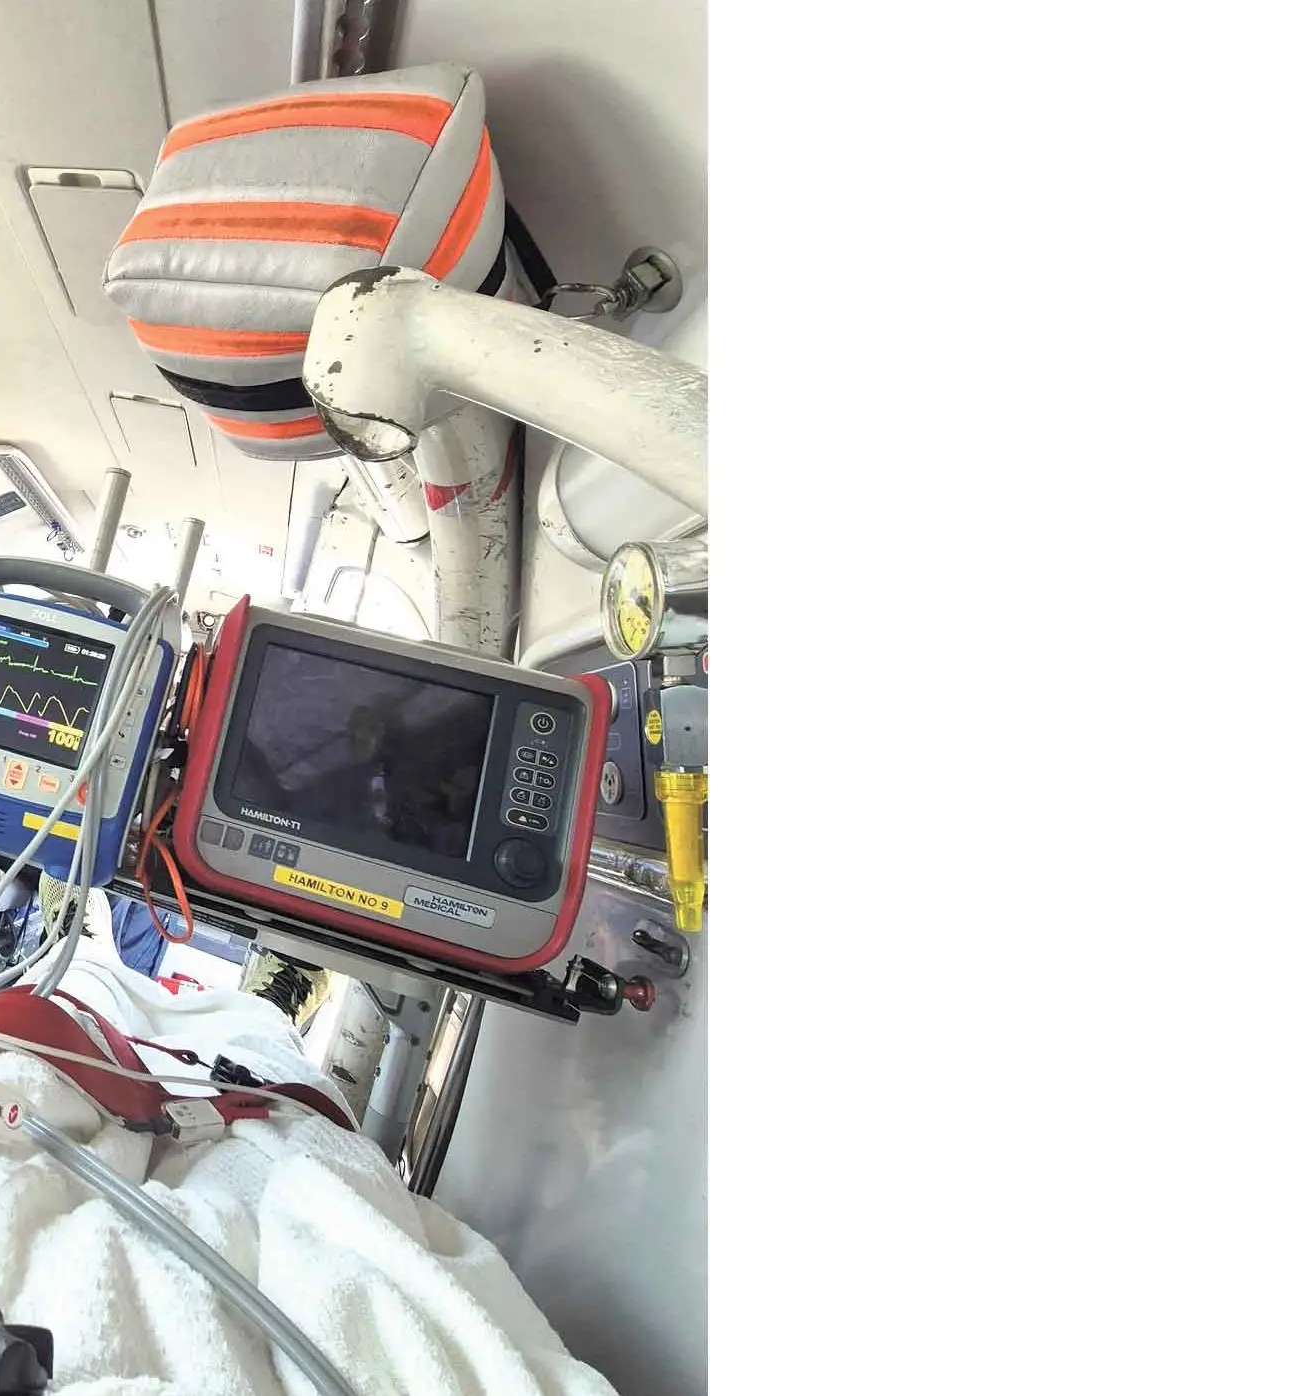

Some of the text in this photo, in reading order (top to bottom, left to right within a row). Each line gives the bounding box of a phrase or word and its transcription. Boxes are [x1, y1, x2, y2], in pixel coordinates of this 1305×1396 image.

[289, 874, 389, 910] HAMILTON NO 9
[414, 897, 461, 917] MEDICAL
[432, 895, 488, 917] HAMILTON
